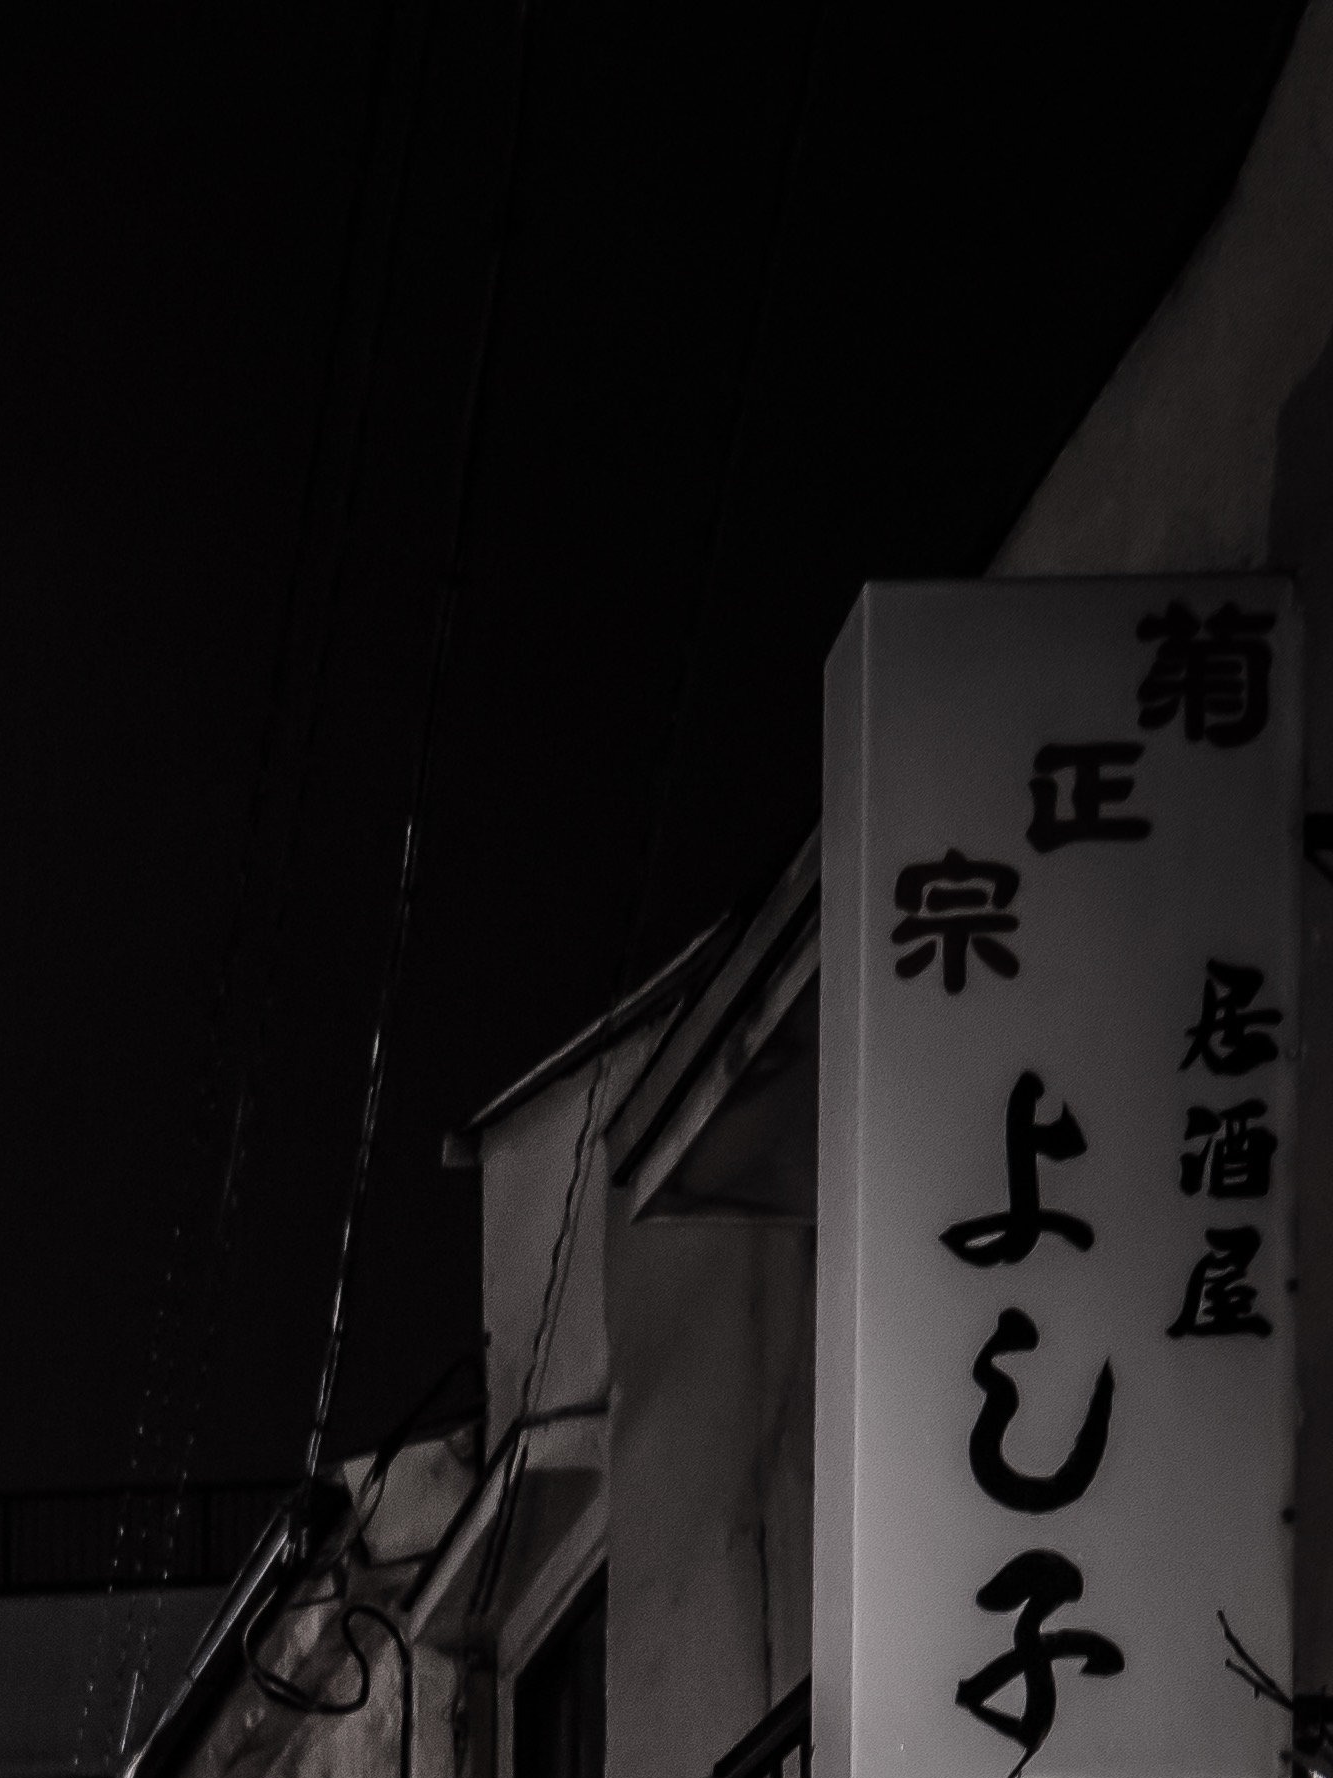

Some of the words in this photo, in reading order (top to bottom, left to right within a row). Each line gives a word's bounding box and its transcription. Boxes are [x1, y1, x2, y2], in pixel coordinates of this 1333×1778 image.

[892, 603, 1277, 993] 菊正宗
[1169, 959, 1283, 1338] 居酒屋
[939, 1072, 1125, 1752] よし子
